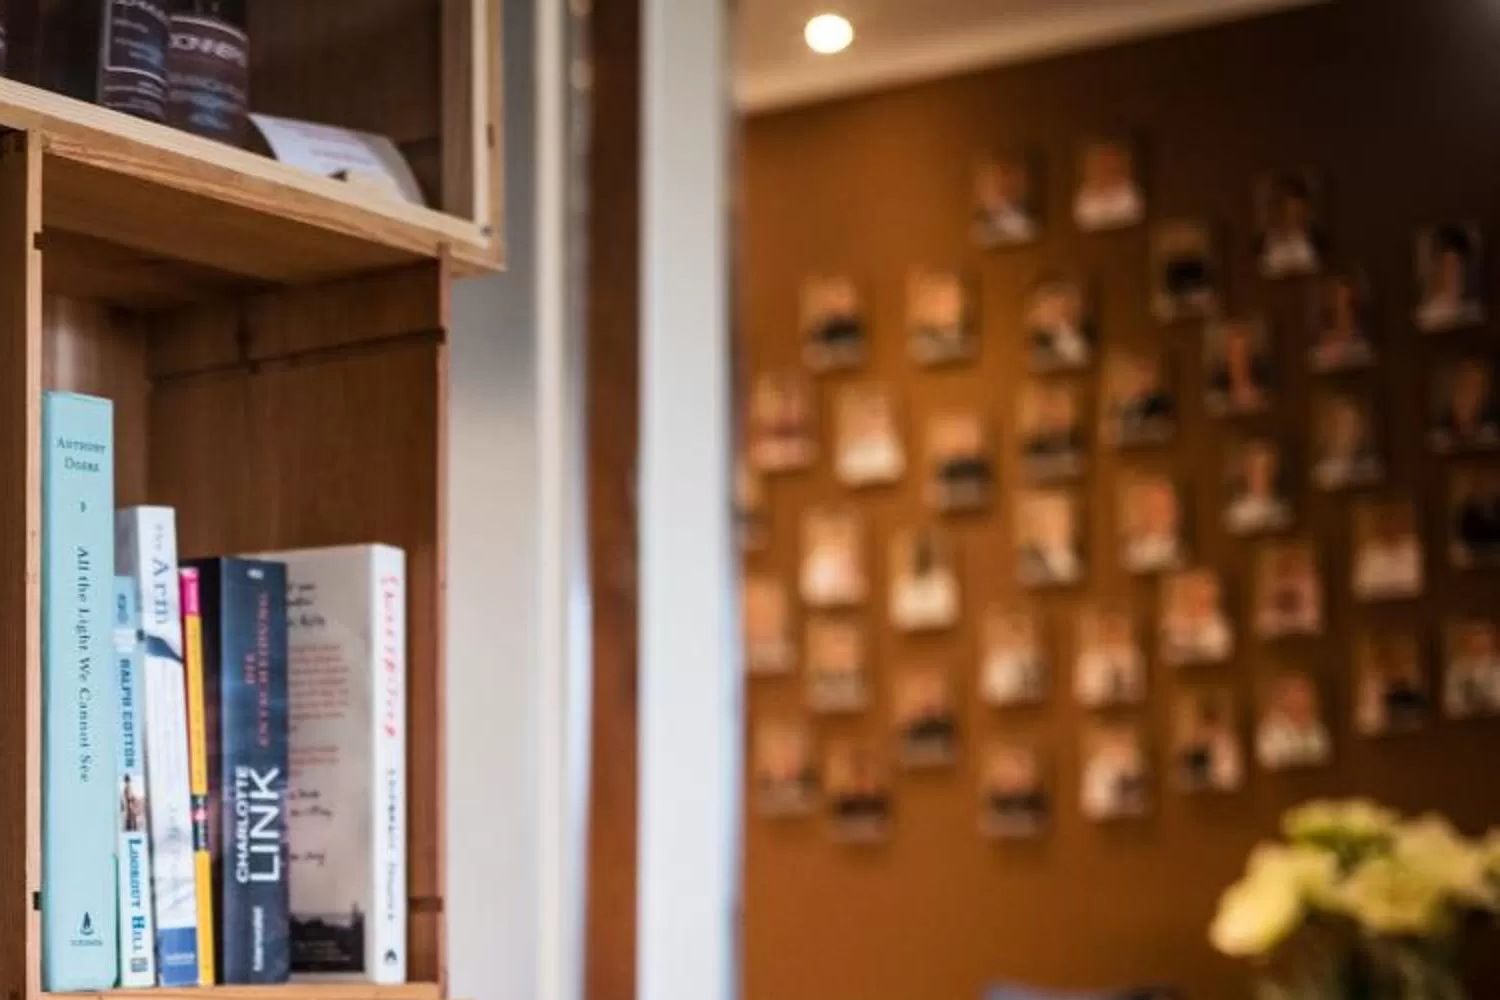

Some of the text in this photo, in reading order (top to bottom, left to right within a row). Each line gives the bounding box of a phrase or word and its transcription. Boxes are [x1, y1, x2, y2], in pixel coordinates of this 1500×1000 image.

[75, 546, 92, 783] All the Light We Cannot See
[119, 659, 135, 768] RALPH COTTON
[235, 766, 250, 884] CHARLOTTE
[249, 767, 281, 882] LINK
